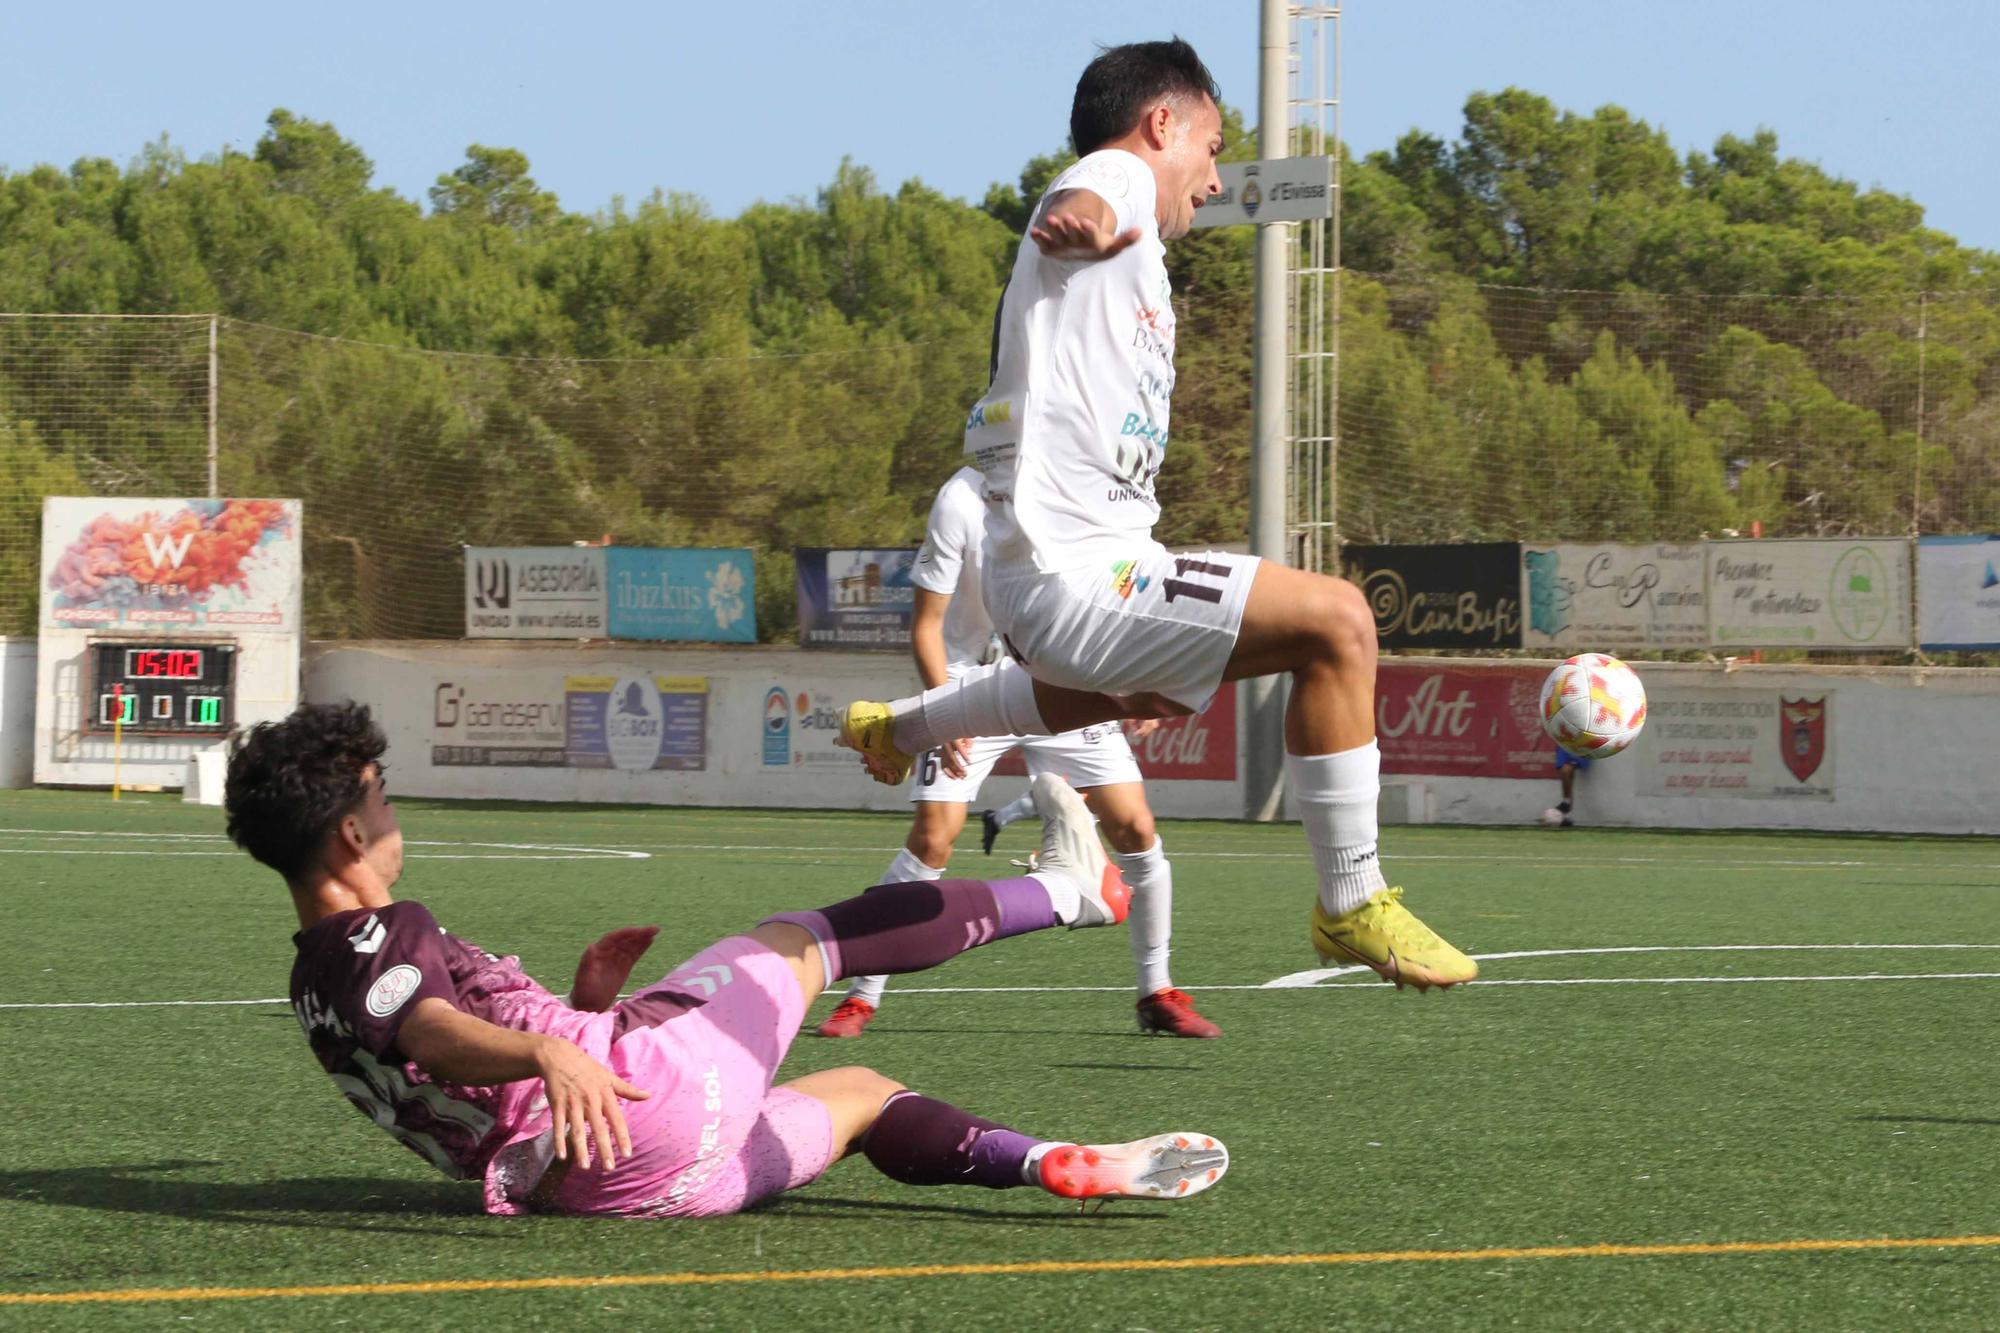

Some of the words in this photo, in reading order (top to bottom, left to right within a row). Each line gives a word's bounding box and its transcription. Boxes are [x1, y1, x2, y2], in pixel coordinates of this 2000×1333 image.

[1268, 181, 1326, 202] d'Eivissa
[143, 532, 194, 569] W
[143, 583, 189, 597] IBIZA
[518, 557, 600, 592] ASESORÍA
[617, 571, 702, 610] ibizkus
[135, 651, 201, 677] 15:02
[200, 698, 218, 724] 0
[1378, 674, 1477, 738] Art
[703, 1064, 722, 1112] SOL
